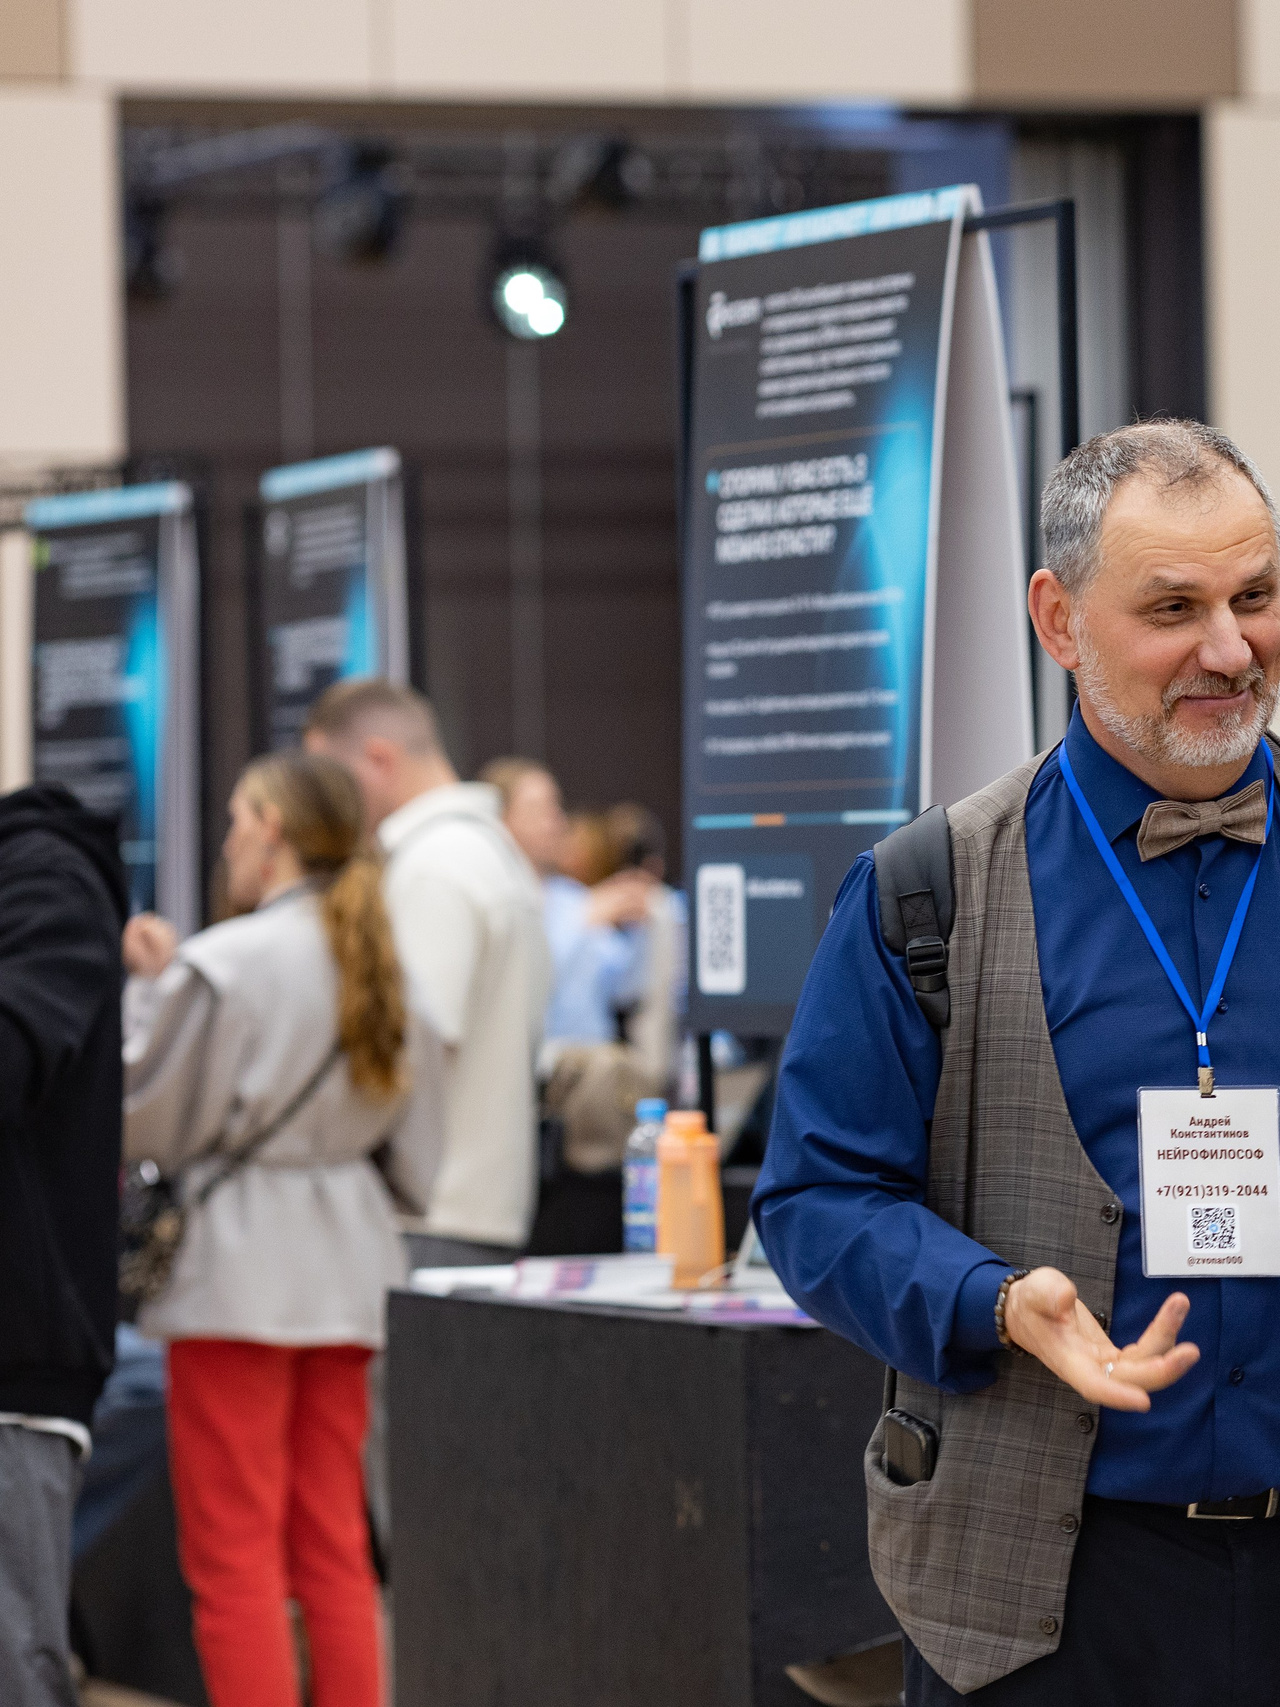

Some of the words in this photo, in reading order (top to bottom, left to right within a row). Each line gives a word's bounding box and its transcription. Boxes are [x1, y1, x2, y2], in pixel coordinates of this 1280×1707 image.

[1189, 1116, 1231, 1128] Андрей
[1170, 1129, 1249, 1139] Константинов
[1157, 1147, 1264, 1160] НЕЙРОФИЛОСОФ
[1156, 1185, 1269, 1199] +7(921)319-2044
